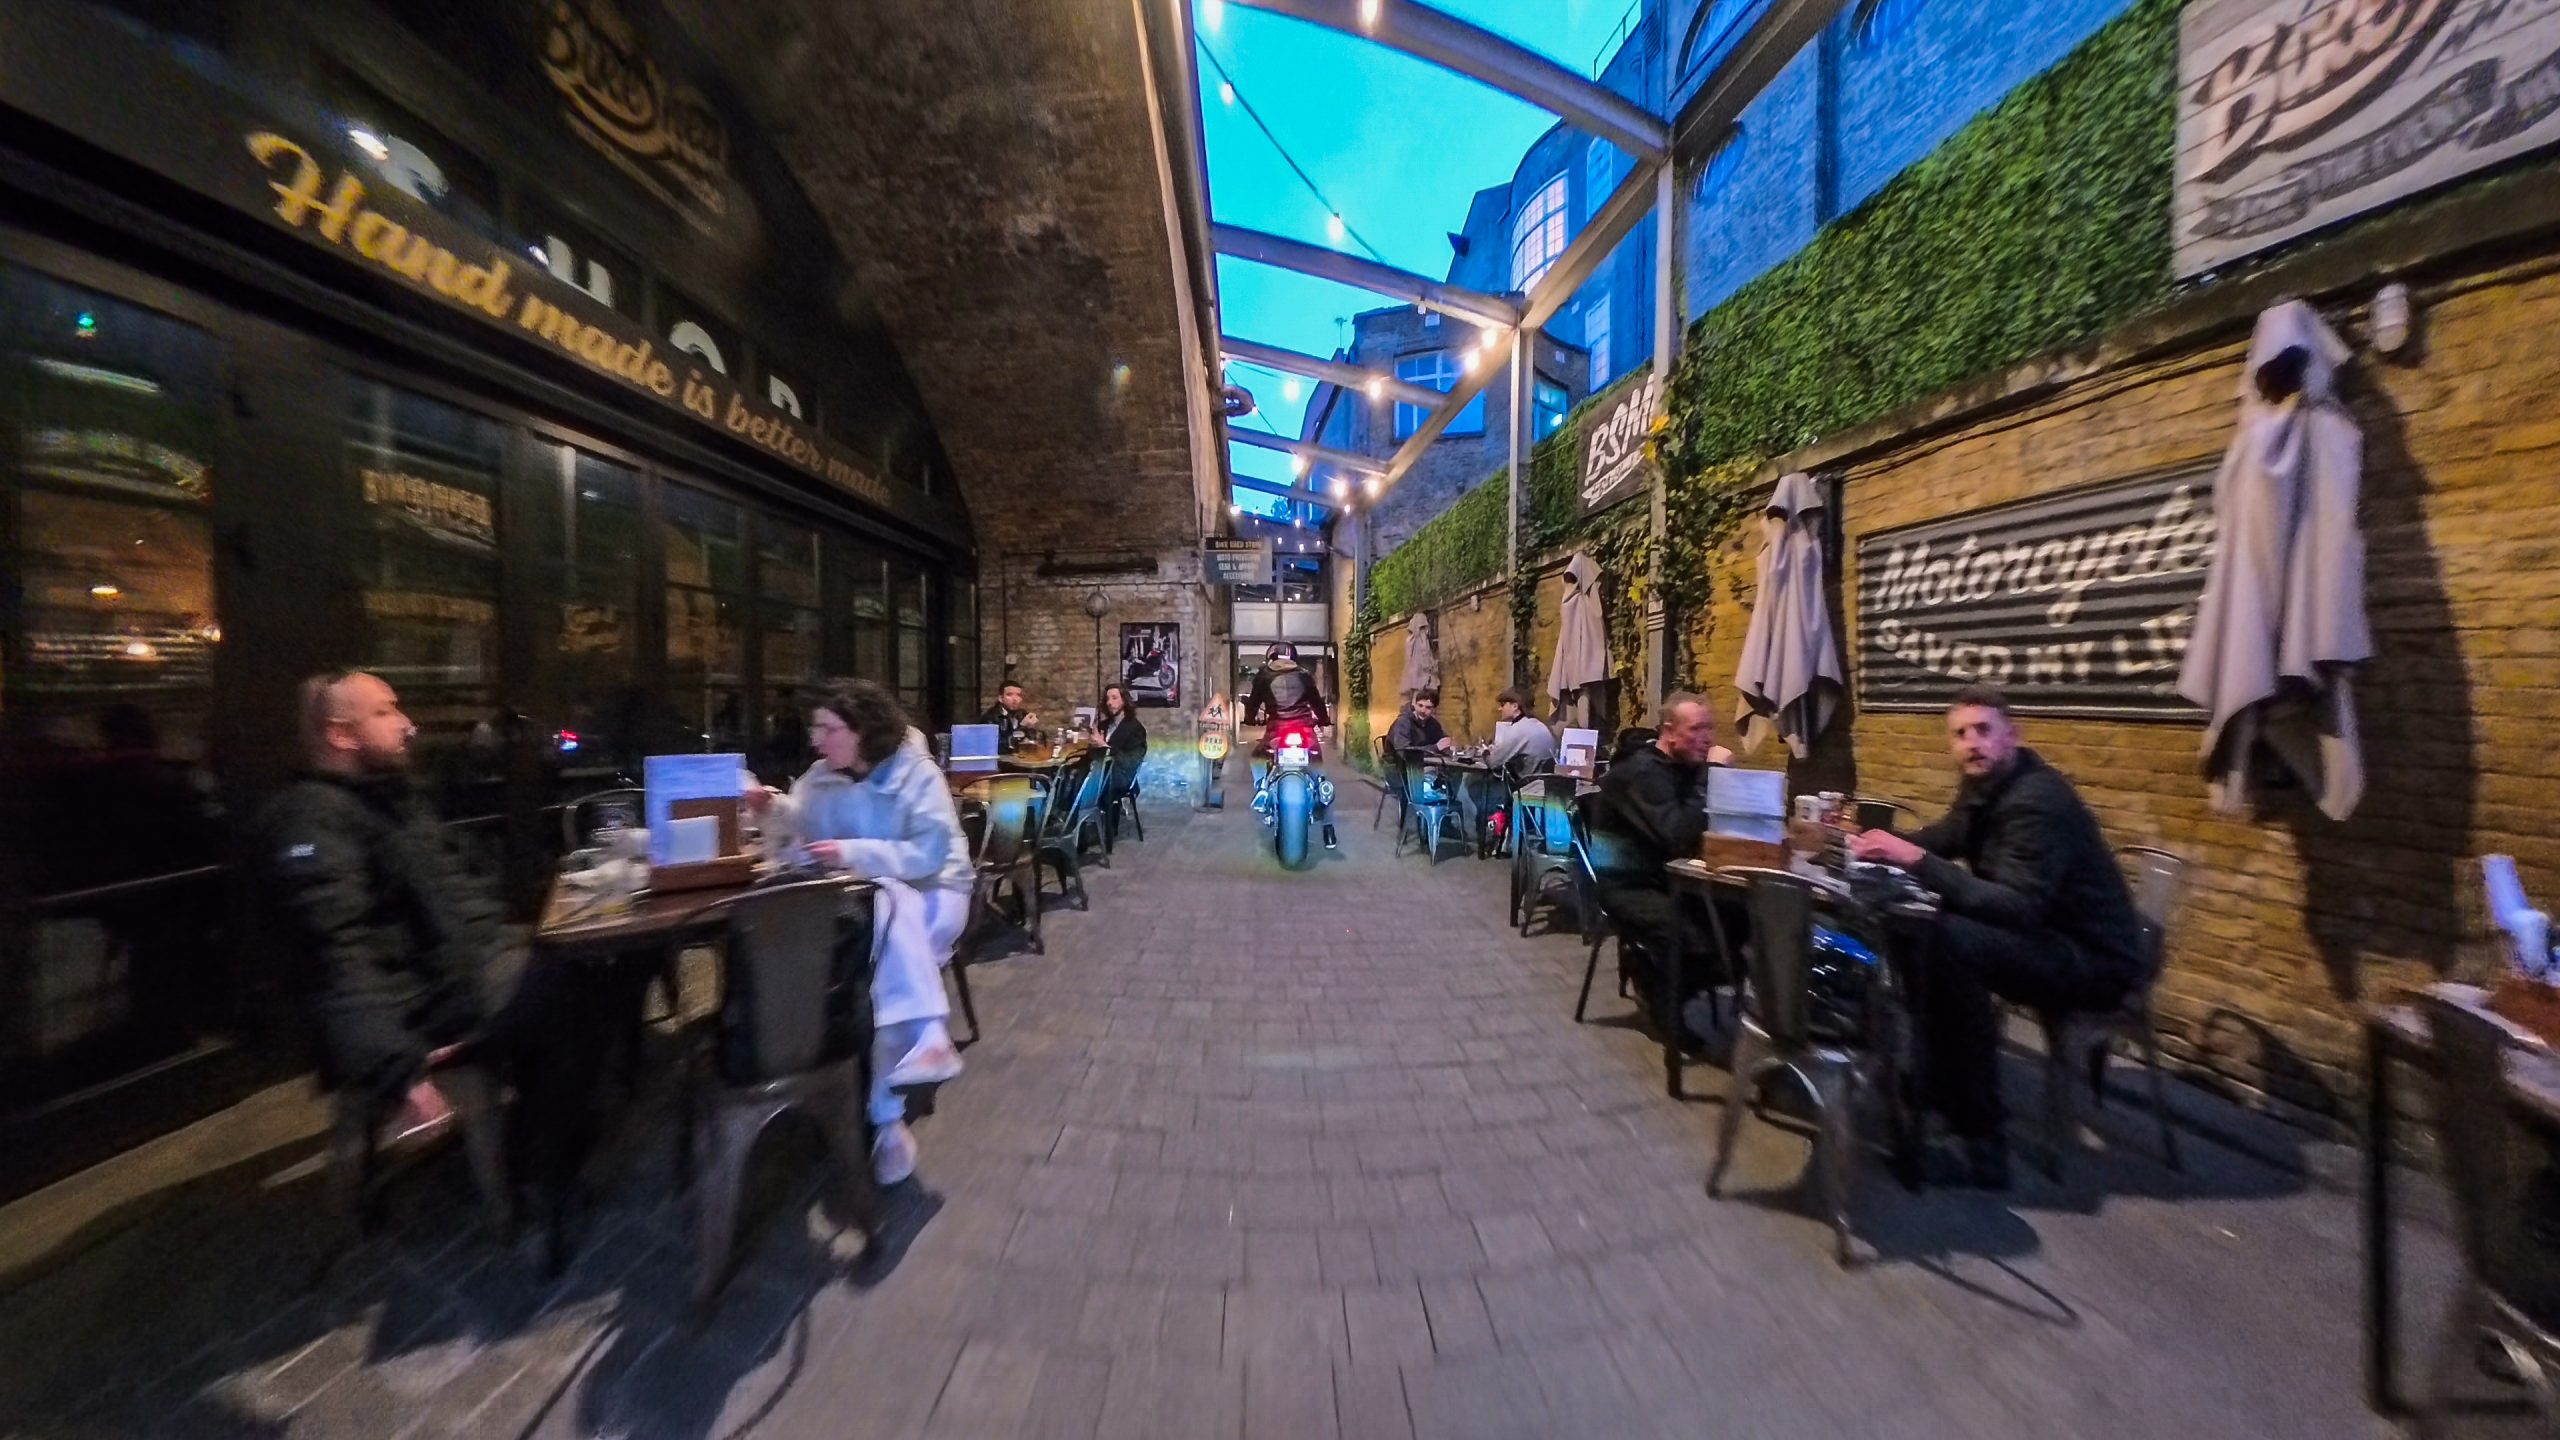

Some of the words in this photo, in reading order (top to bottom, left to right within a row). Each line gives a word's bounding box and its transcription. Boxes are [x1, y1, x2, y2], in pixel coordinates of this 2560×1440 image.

[246, 132, 514, 318] Hand
[519, 294, 675, 397] made
[682, 368, 715, 420] is
[726, 393, 823, 473] better
[826, 457, 891, 506] made
[1872, 484, 2218, 628] Motorcycle
[1874, 617, 2014, 684] SAVED
[2025, 640, 2095, 684] MY
